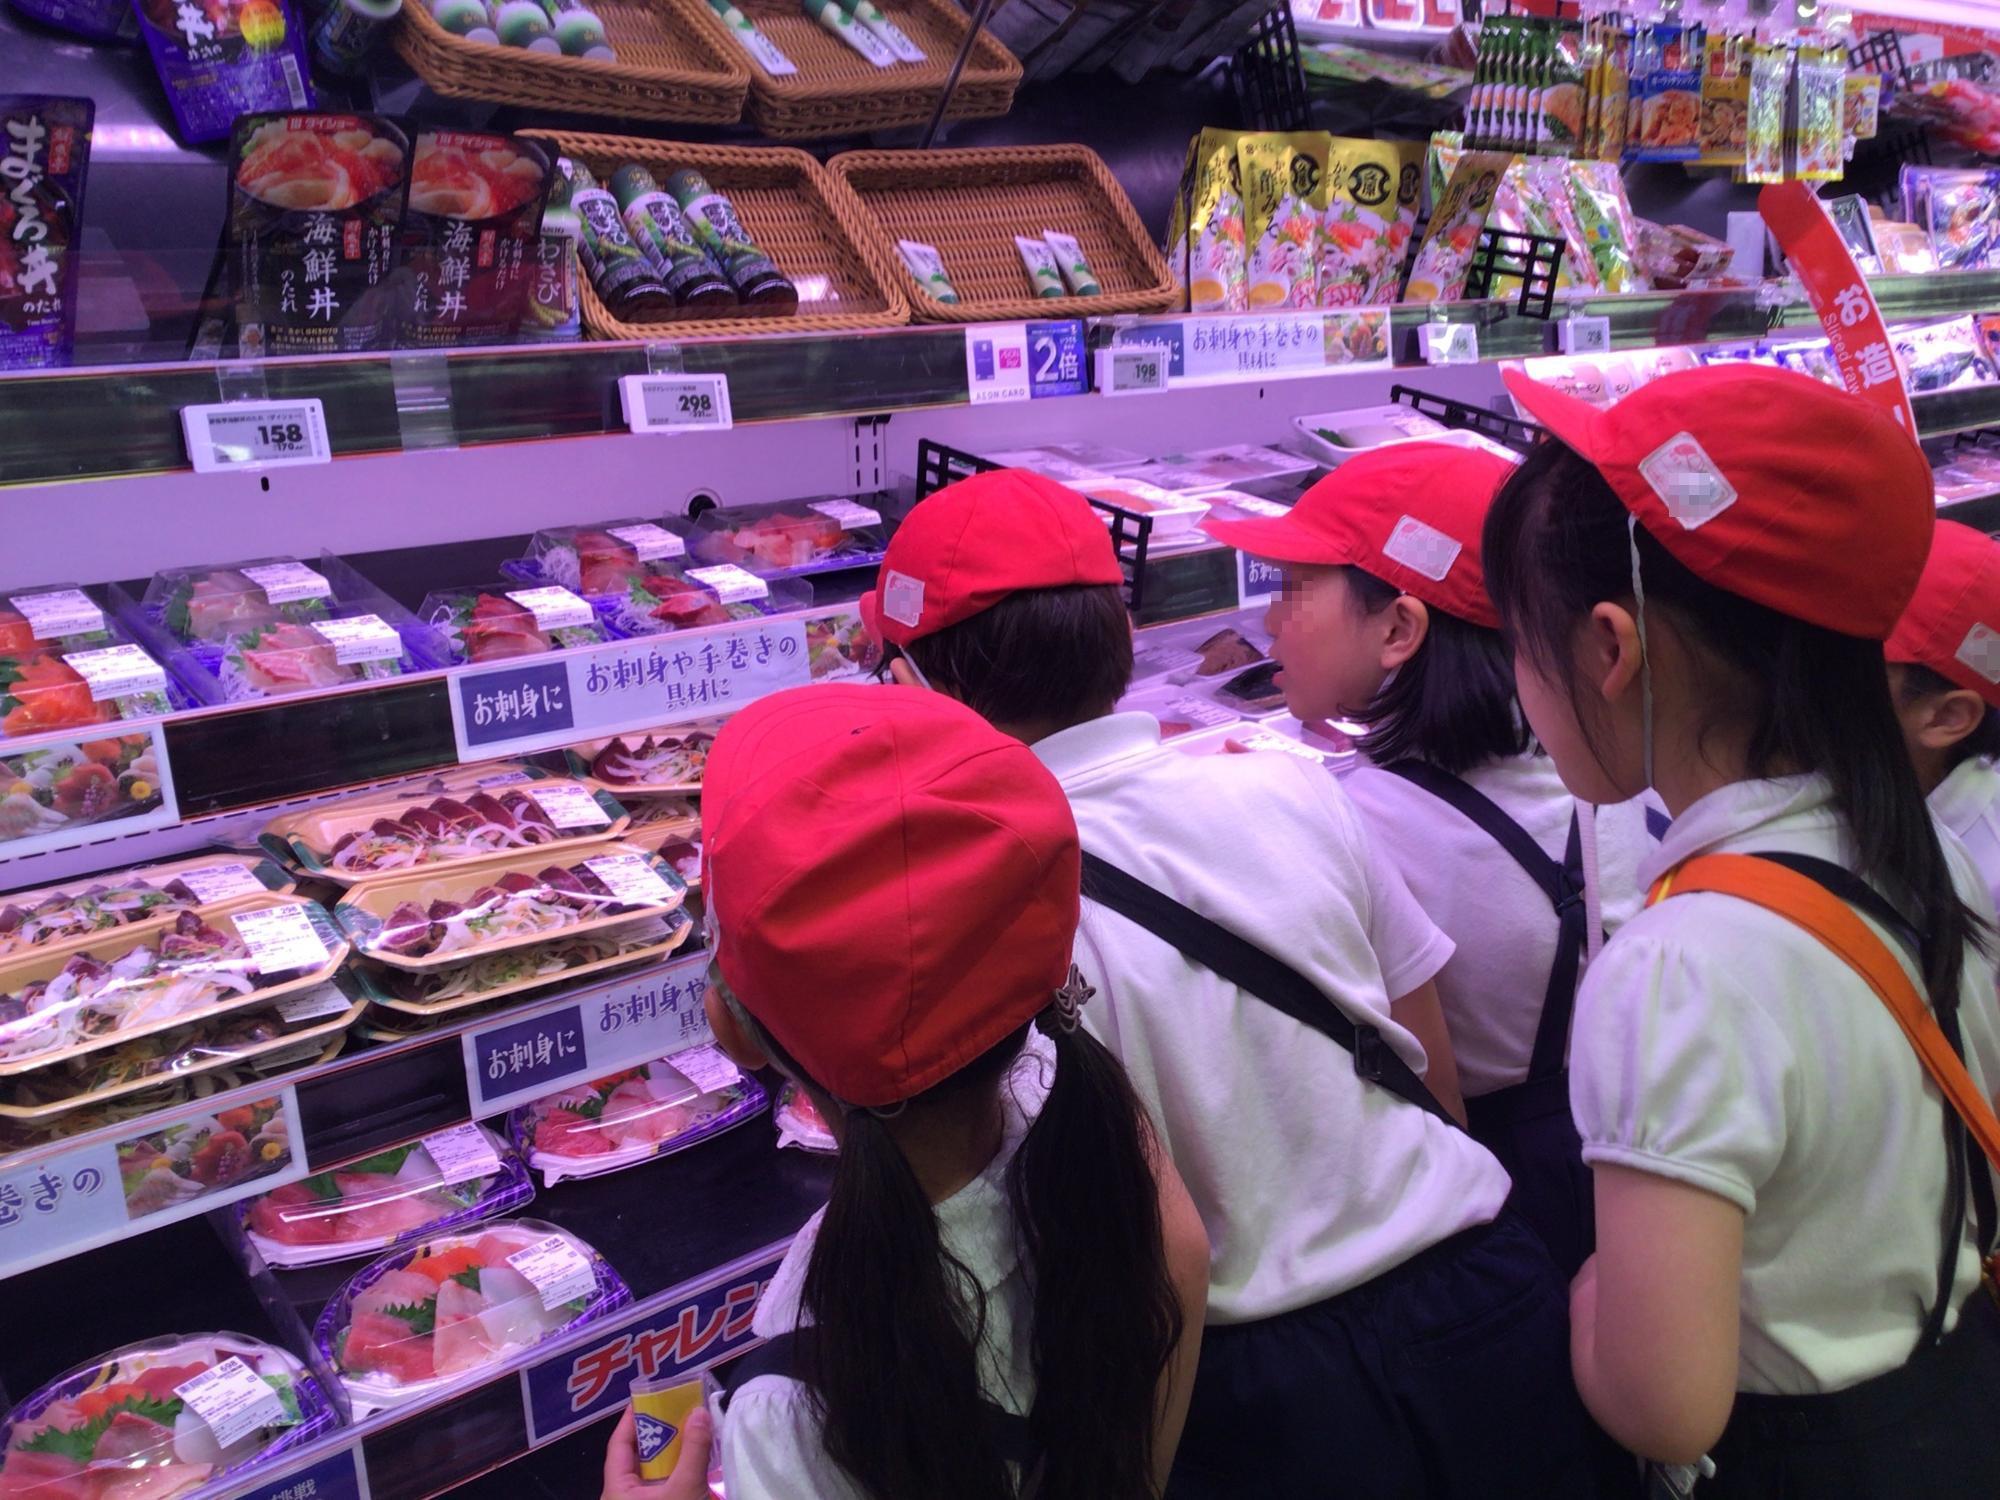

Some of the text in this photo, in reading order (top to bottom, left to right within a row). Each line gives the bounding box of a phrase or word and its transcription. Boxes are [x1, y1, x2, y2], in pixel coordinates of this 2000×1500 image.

[0, 114, 59, 295] まぐろ丼
[302, 212, 340, 322] 海鮮丼
[435, 220, 474, 322] 海鮮丼
[537, 237, 561, 304] わさび
[22, 298, 62, 313] のたれ
[280, 269, 298, 313] のたれ
[413, 271, 430, 313] のたれ
[1193, 322, 1318, 351] お刺身や手巻きの
[1823, 312, 1861, 395] Sliced raw
[1034, 336, 1080, 382] 2倍
[1135, 363, 1157, 379] 198
[1238, 351, 1276, 371] 具材に
[678, 394, 712, 412] 298
[976, 390, 1000, 400] AEON
[258, 423, 304, 445] 158
[586, 634, 797, 694] お刺身や手巻きの
[473, 683, 563, 726] お刺身に
[665, 677, 730, 708] 具材に
[280, 905, 298, 915] 298
[488, 1029, 577, 1080] お刺身に
[219, 1360, 239, 1373] 698
